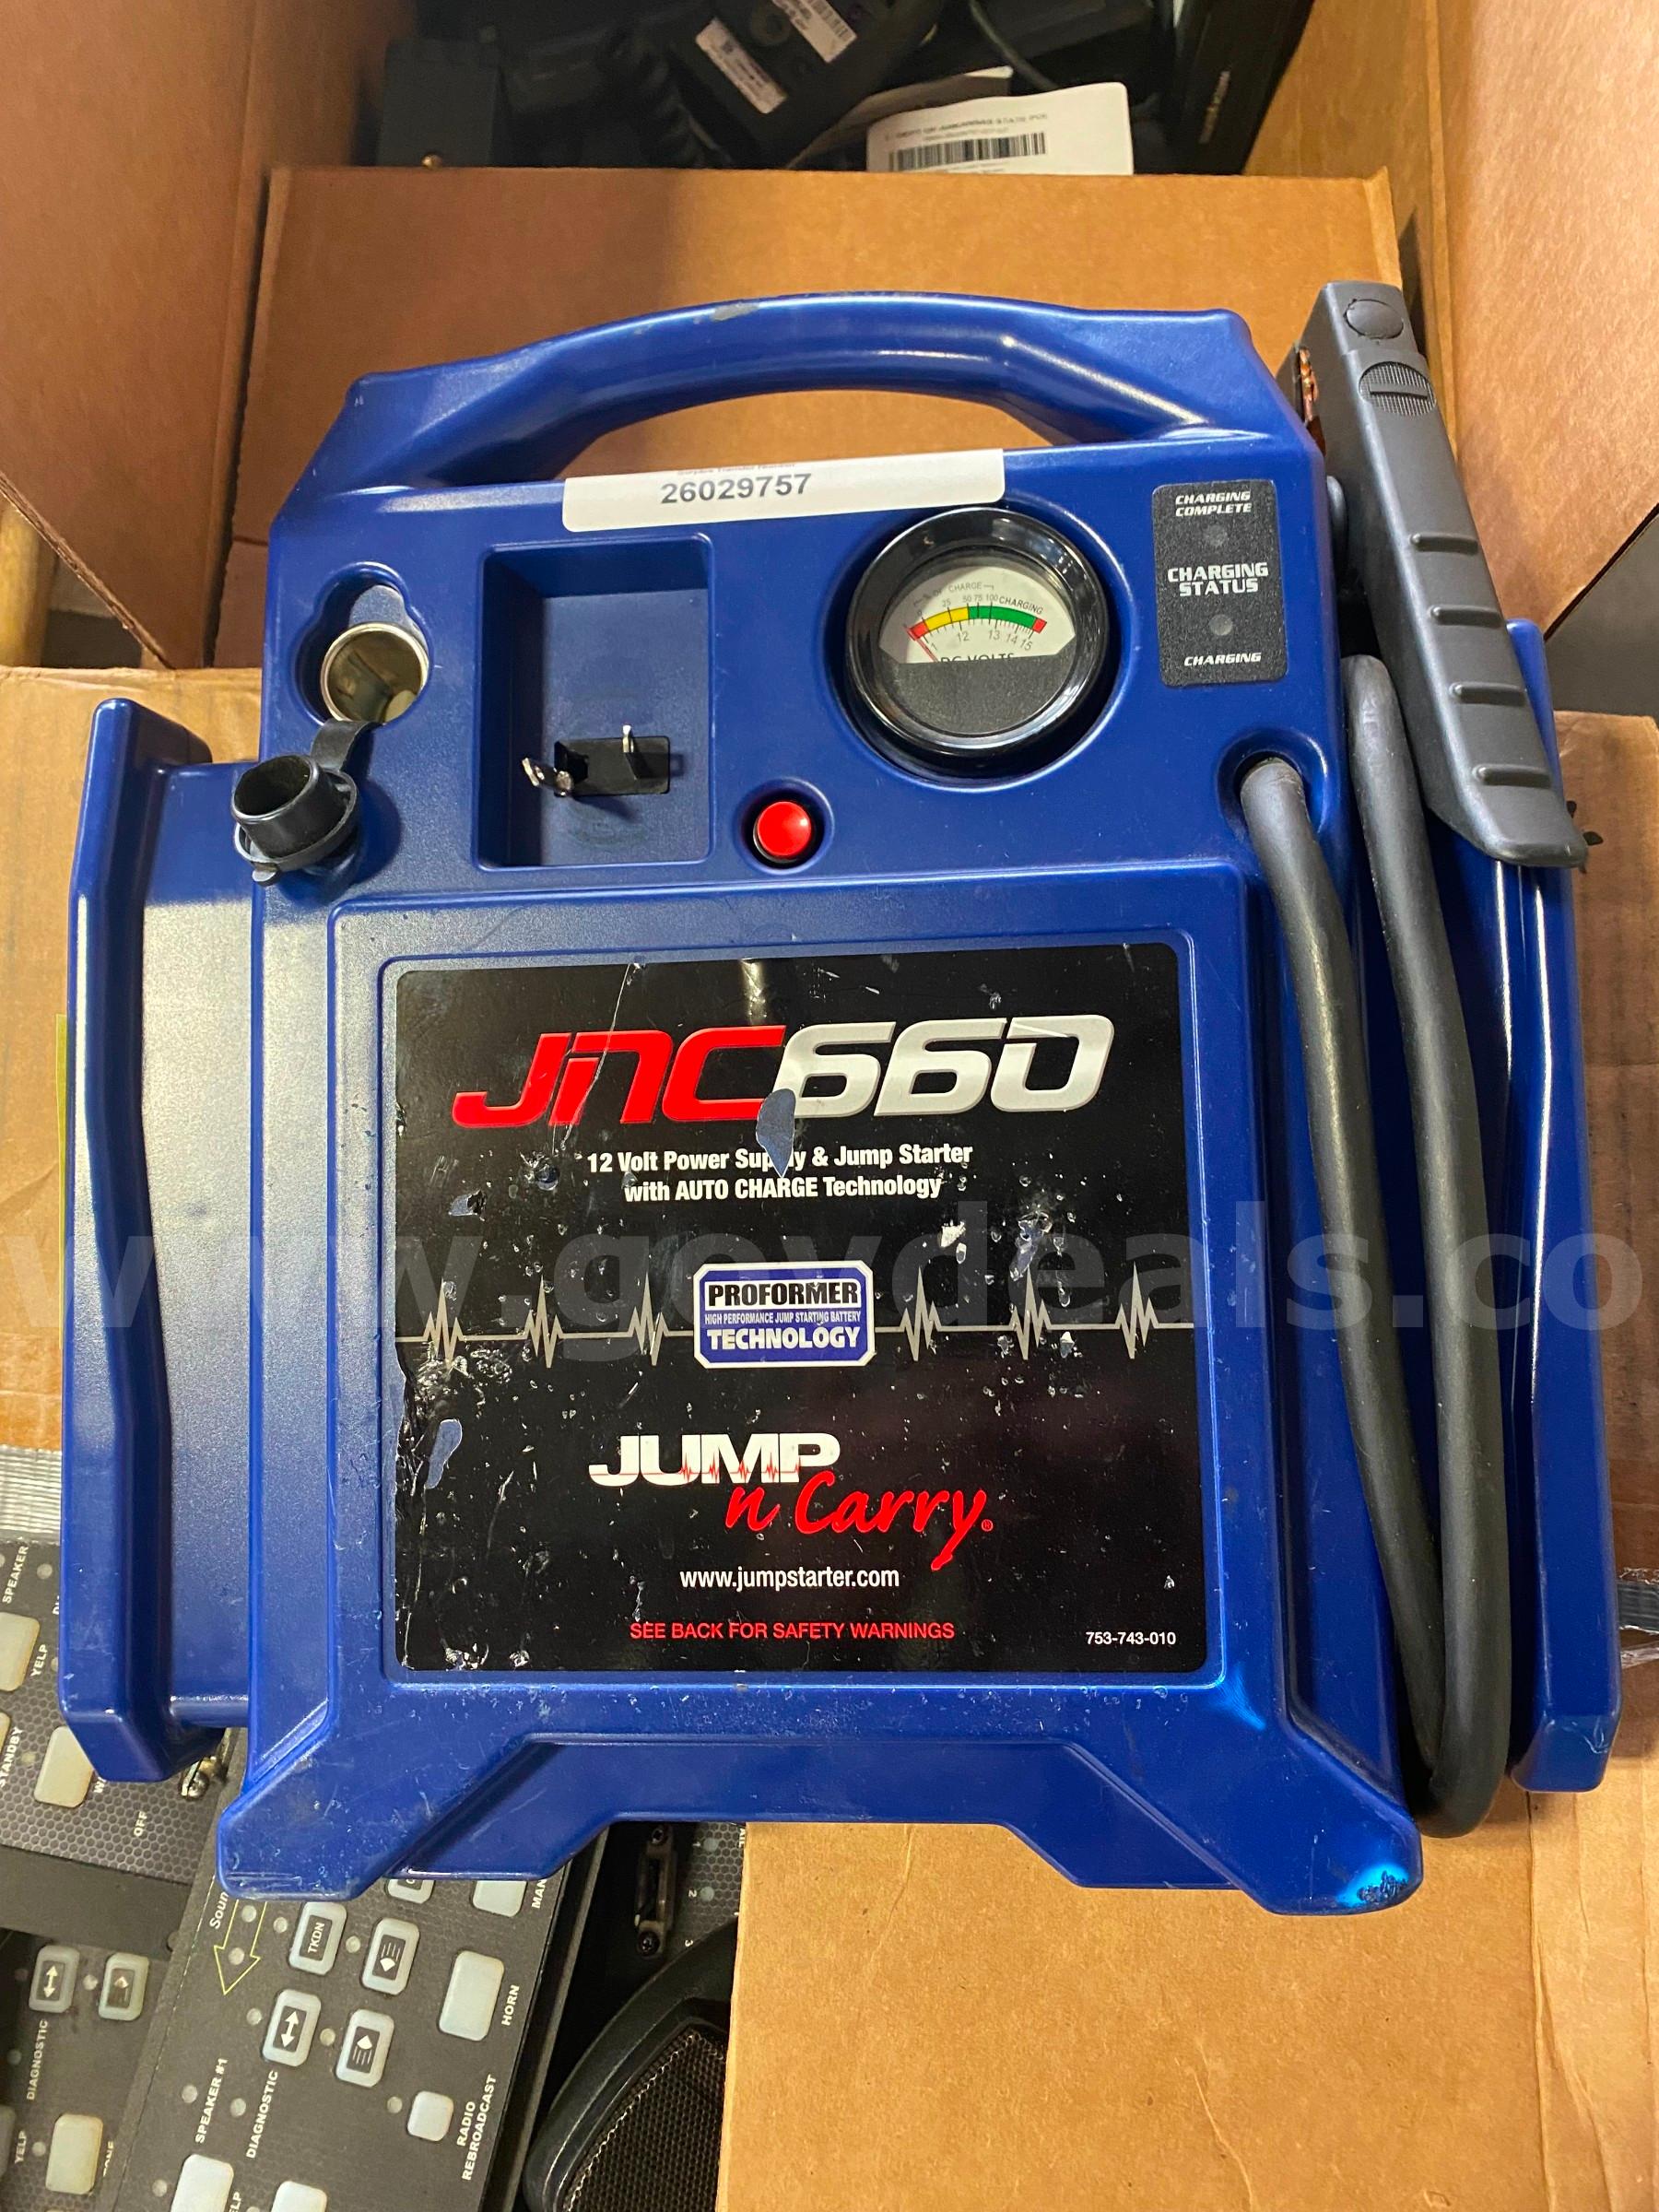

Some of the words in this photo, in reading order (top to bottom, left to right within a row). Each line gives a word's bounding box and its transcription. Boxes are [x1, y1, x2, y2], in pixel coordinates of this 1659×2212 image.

[661, 472, 812, 504] 26029757
[1175, 491, 1251, 505] CHARGING
[1175, 502, 1252, 517] COMPLETE
[1168, 562, 1268, 582] CHARGING
[948, 582, 982, 593] CHARGE
[1179, 579, 1259, 596] STATUS
[999, 595, 1043, 615] CHARGING
[957, 633, 969, 641] 12
[989, 630, 1000, 641] 13
[1006, 633, 1018, 643] 14
[1021, 639, 1032, 651] 15
[1183, 653, 1262, 666] CHARGING
[587, 1153, 613, 1173] 12
[618, 1152, 662, 1172] Volt
[665, 1151, 729, 1171] Power
[735, 1148, 806, 1173] Suply
[812, 1146, 829, 1166] &
[833, 1147, 893, 1168] Jump
[899, 1142, 973, 1165] Starter
[625, 1181, 670, 1203] with
[675, 1180, 729, 1201] AUTO
[735, 1177, 818, 1199] CHARGE
[823, 1175, 942, 1199] Technology
[708, 1281, 858, 1306] PROFORMER
[705, 1313, 723, 1324] HIGH
[724, 1312, 774, 1324] PERFORMANCE
[775, 1312, 794, 1324] JUMP
[795, 1311, 829, 1324] STARTING
[830, 1311, 862, 1323] BATTERY
[707, 1326, 861, 1350] TECHNOLOGY
[588, 1432, 841, 1486] JUMP
[724, 1485, 781, 1532] n
[2, 1545, 29, 1605] SPEAKER
[679, 1566, 900, 1592] www.jumpstarter.com
[629, 1622, 665, 1639] SEE
[672, 1622, 724, 1639] BACK
[728, 1622, 768, 1639] FOR
[772, 1622, 845, 1639] SAFETY
[850, 1621, 955, 1639] WARNINGS
[1086, 1631, 1176, 1645] 753-743-010
[29, 1643, 48, 1678] YELP
[134, 1810, 147, 1837] OFF
[307, 1922, 325, 1954] TKDN
[501, 1984, 520, 2026] HORN
[26, 2019, 49, 2100] DIAGNOSTIC
[194, 2077, 222, 2144] SPEAKER
[215, 2058, 229, 2076] #1
[246, 2070, 278, 2159] DIAGNOSTIC
[456, 2101, 476, 2147] RADIO
[461, 2074, 497, 2181] REBROADCAST
[14, 2130, 28, 2164] YELP
